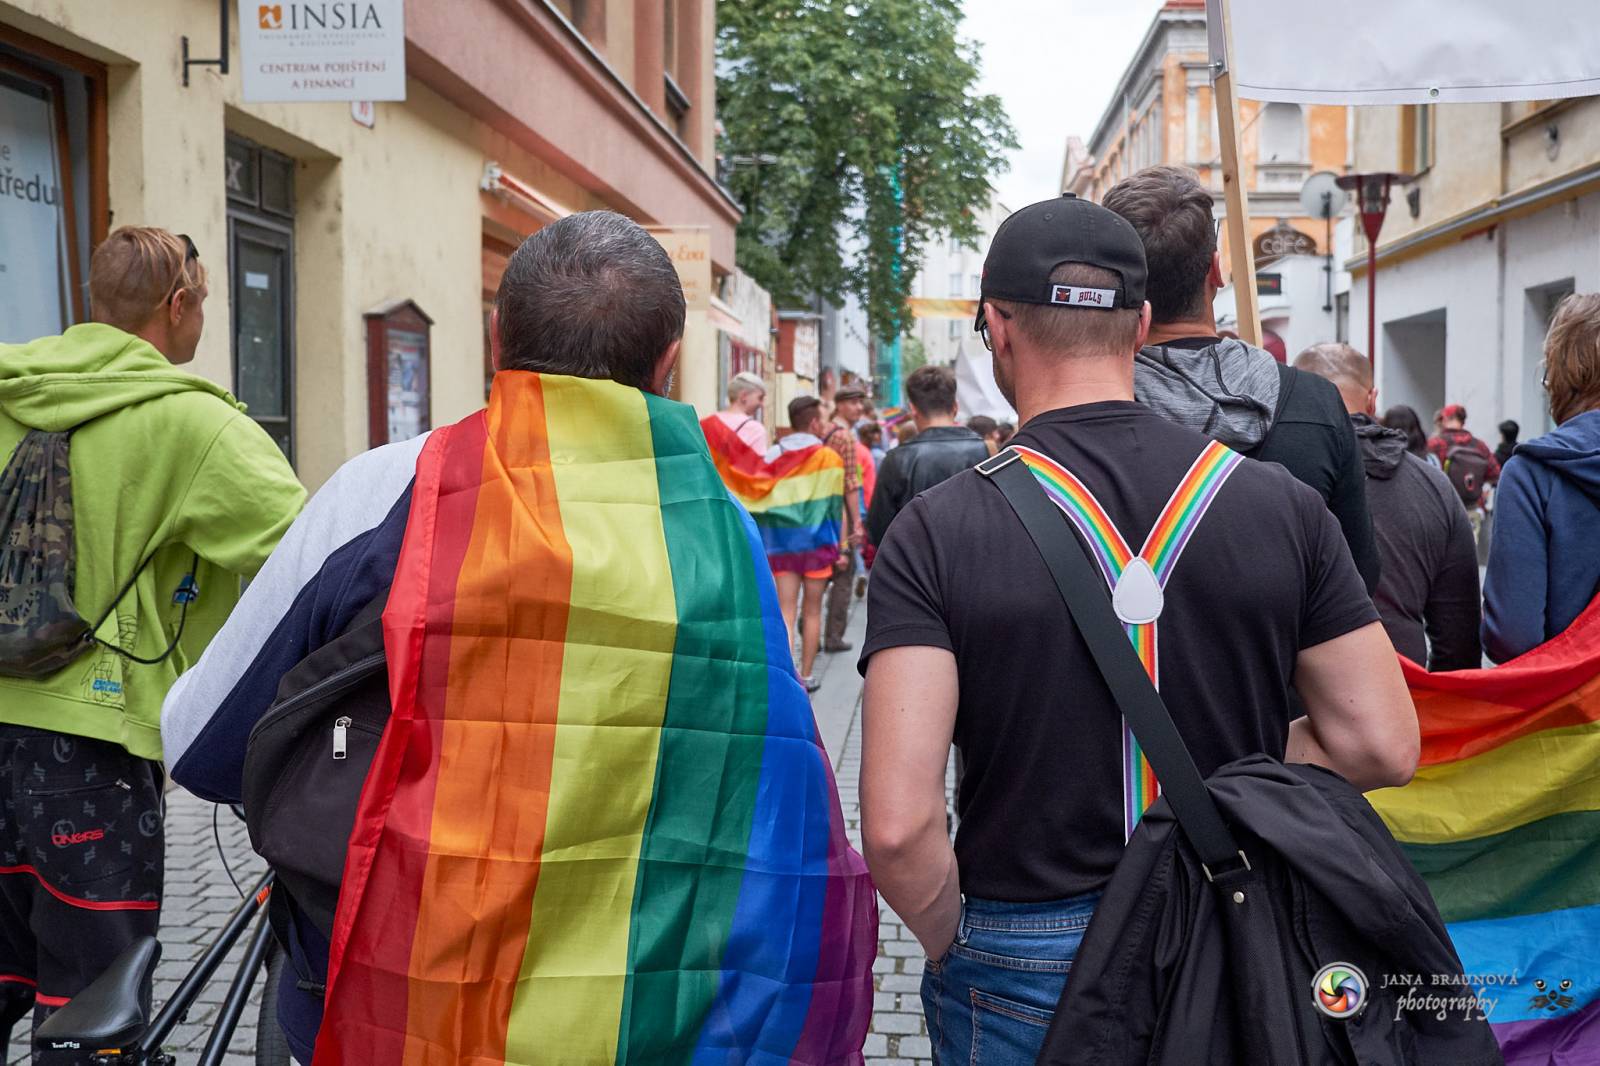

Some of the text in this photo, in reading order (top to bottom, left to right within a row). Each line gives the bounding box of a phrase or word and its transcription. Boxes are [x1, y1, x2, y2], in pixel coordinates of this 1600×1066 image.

[291, 3, 382, 30] INSIA
[259, 63, 320, 74] CENTRUM
[291, 79, 300, 89] A
[1078, 291, 1103, 305] BULLS
